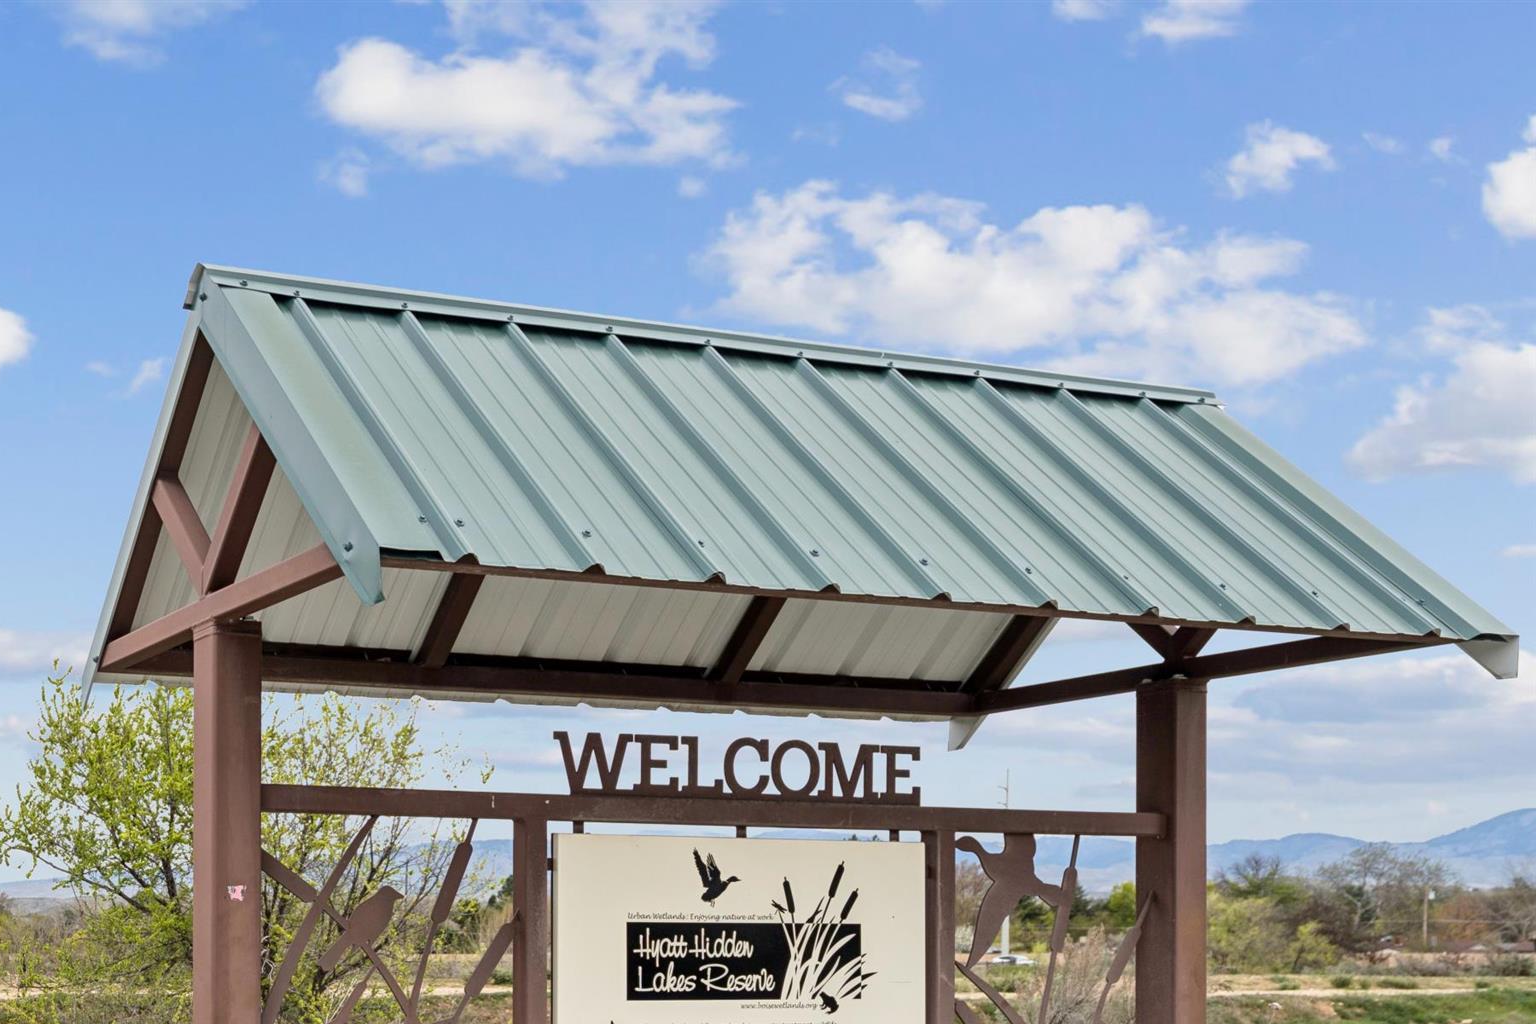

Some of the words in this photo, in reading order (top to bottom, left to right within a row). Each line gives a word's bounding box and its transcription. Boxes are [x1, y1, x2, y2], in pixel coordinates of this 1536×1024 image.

[553, 730, 921, 806] WELCOME
[627, 912, 651, 920] Urban
[690, 913, 720, 922] Enjoying
[757, 912, 774, 920] work
[633, 927, 688, 967] Hyatt
[688, 927, 754, 960] Hidden
[634, 961, 697, 992] Lakes
[698, 963, 776, 992] Reserve
